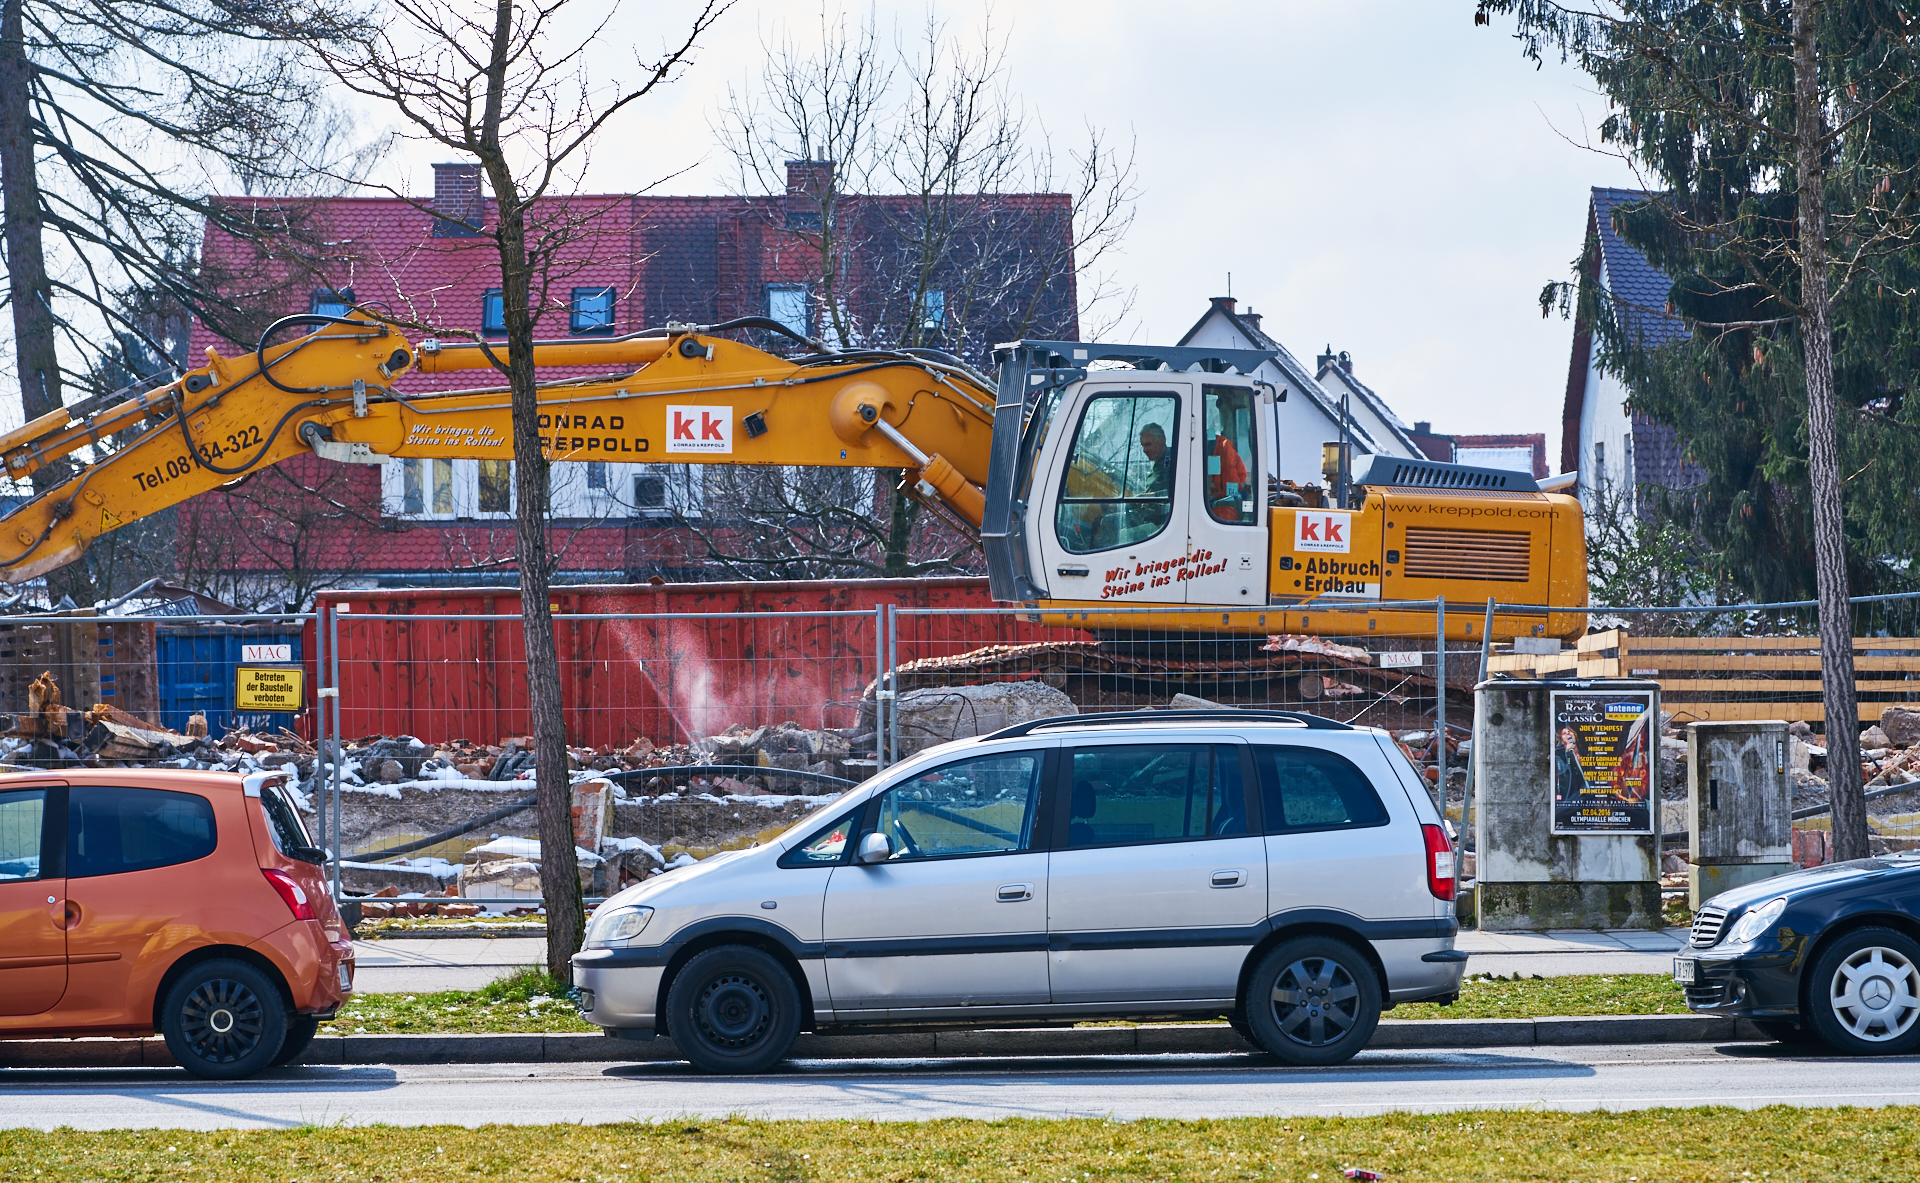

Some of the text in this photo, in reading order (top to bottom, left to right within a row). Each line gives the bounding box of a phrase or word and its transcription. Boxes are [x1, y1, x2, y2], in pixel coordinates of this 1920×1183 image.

[537, 415, 624, 430] ONRAD
[412, 424, 495, 437] Wir bringen die
[406, 435, 505, 447] Steine ins Rollen!
[540, 437, 649, 452] REPPOLD
[1371, 503, 1560, 519] www.kreppold.com
[1105, 549, 1212, 583] Wir bringen die
[1306, 557, 1380, 577] Abbruch
[1100, 558, 1228, 599] Steine ins Rollen!
[1305, 575, 1366, 594] Erdbau
[248, 646, 288, 660] MAC
[1387, 652, 1416, 664] MAC
[254, 672, 285, 682] Betreten
[246, 682, 293, 692] der Baustelle
[254, 693, 285, 702] verboten
[1608, 705, 1642, 713] antenne
[1582, 808, 1611, 816] 02.04.2016
